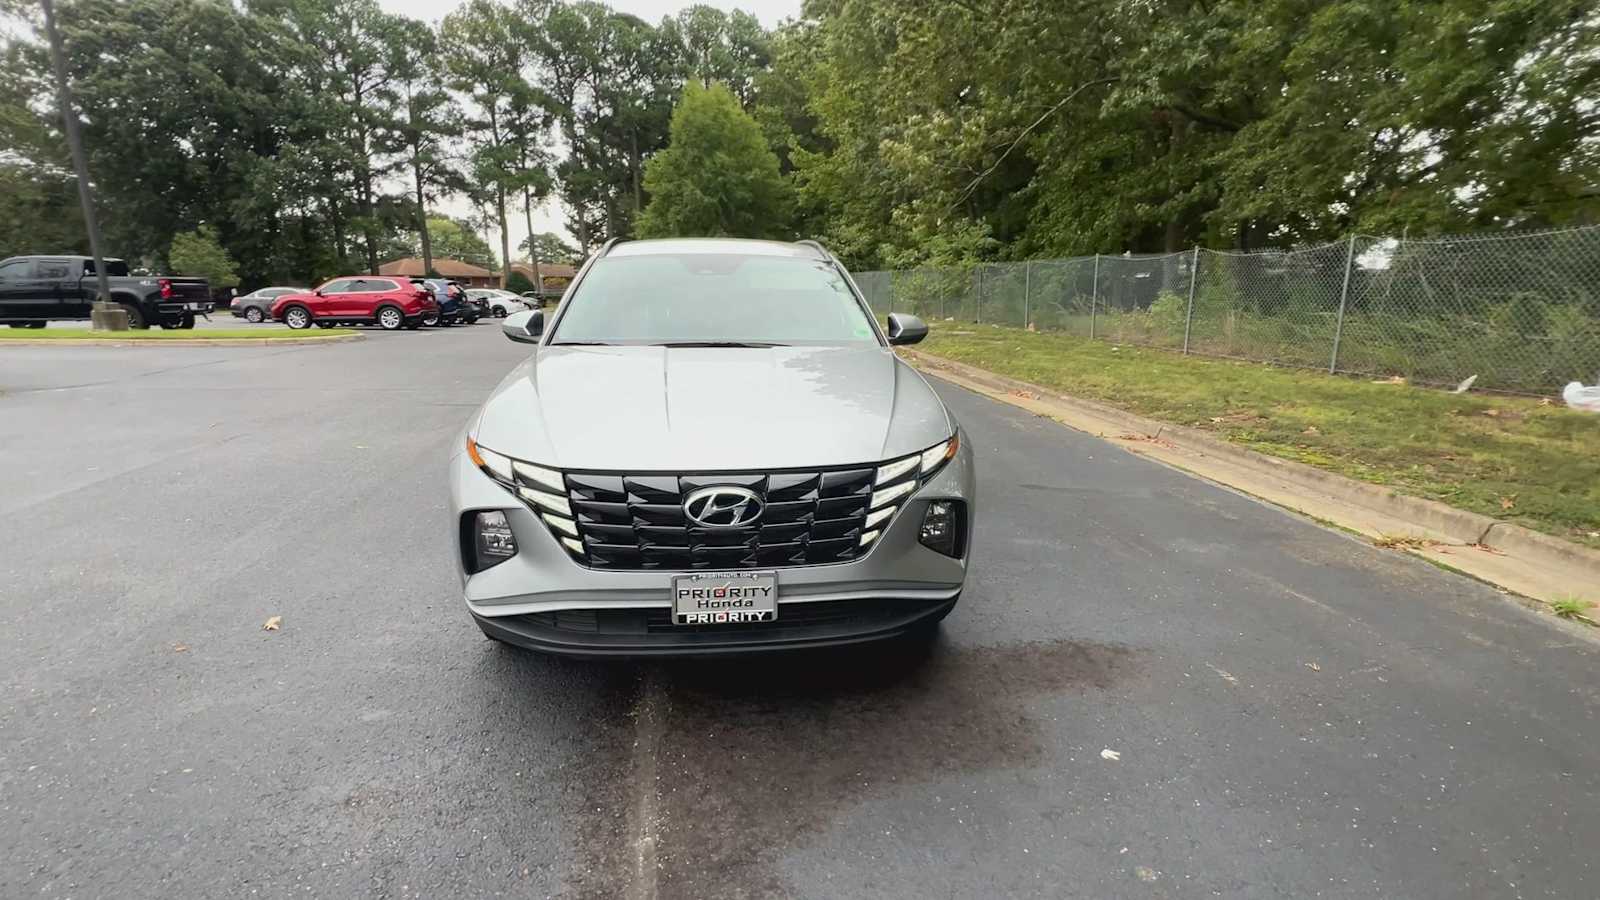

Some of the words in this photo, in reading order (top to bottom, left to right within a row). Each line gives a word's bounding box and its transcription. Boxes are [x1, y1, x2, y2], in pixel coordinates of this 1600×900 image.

[679, 586, 771, 599] PRIORITY
[697, 599, 753, 609] Honda
[686, 612, 765, 624] PRIORITY
